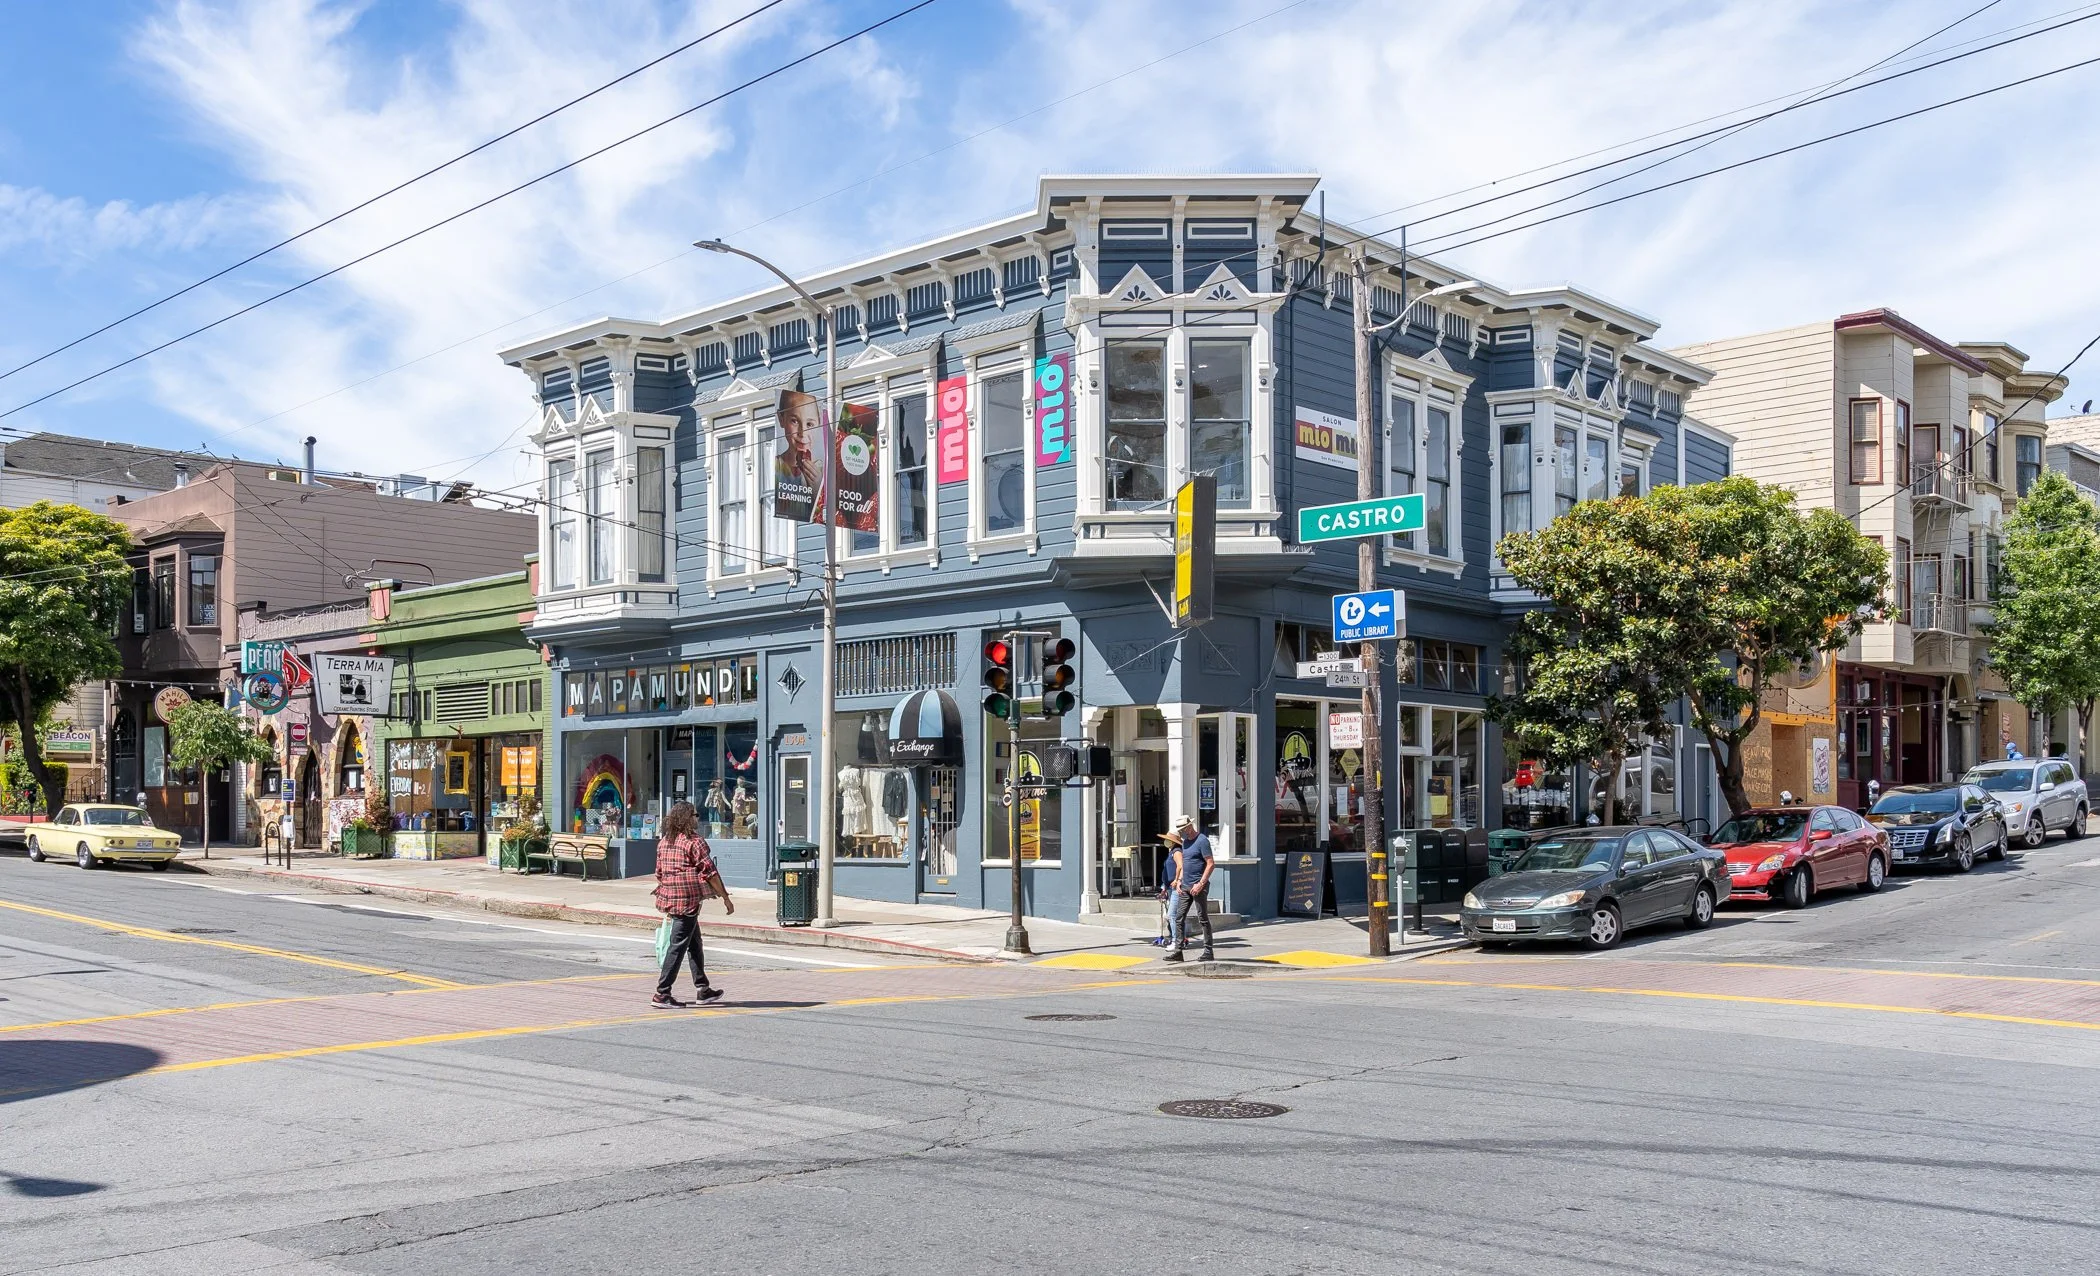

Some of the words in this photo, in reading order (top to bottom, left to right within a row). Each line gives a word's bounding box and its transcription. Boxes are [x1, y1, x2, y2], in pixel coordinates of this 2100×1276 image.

[1322, 415, 1342, 426] SALON
[1299, 424, 1330, 449] mio
[1335, 433, 1358, 455] mi
[778, 482, 798, 492] FOOD
[798, 485, 813, 495] FOR
[778, 491, 812, 504] LEARNING
[838, 489, 862, 502] FOOD
[838, 500, 855, 512] FOR
[856, 499, 874, 514] all
[1318, 505, 1405, 532] CASTRO
[1340, 628, 1361, 639] PUBLIC
[1363, 625, 1389, 636] LIBRARY
[248, 648, 281, 671] PEAK
[1323, 652, 1338, 660] 1300
[326, 657, 361, 671] TERRA
[1309, 665, 1339, 674] Castr
[1334, 674, 1349, 684] 24th
[1352, 675, 1360, 684] St
[570, 666, 752, 706] MAPAMUNDI
[160, 690, 188, 704] MAHILA
[1330, 714, 1340, 725] NO
[53, 732, 90, 740] BEACON
[896, 739, 935, 757] Exchange
[397, 759, 412, 770] NEW
